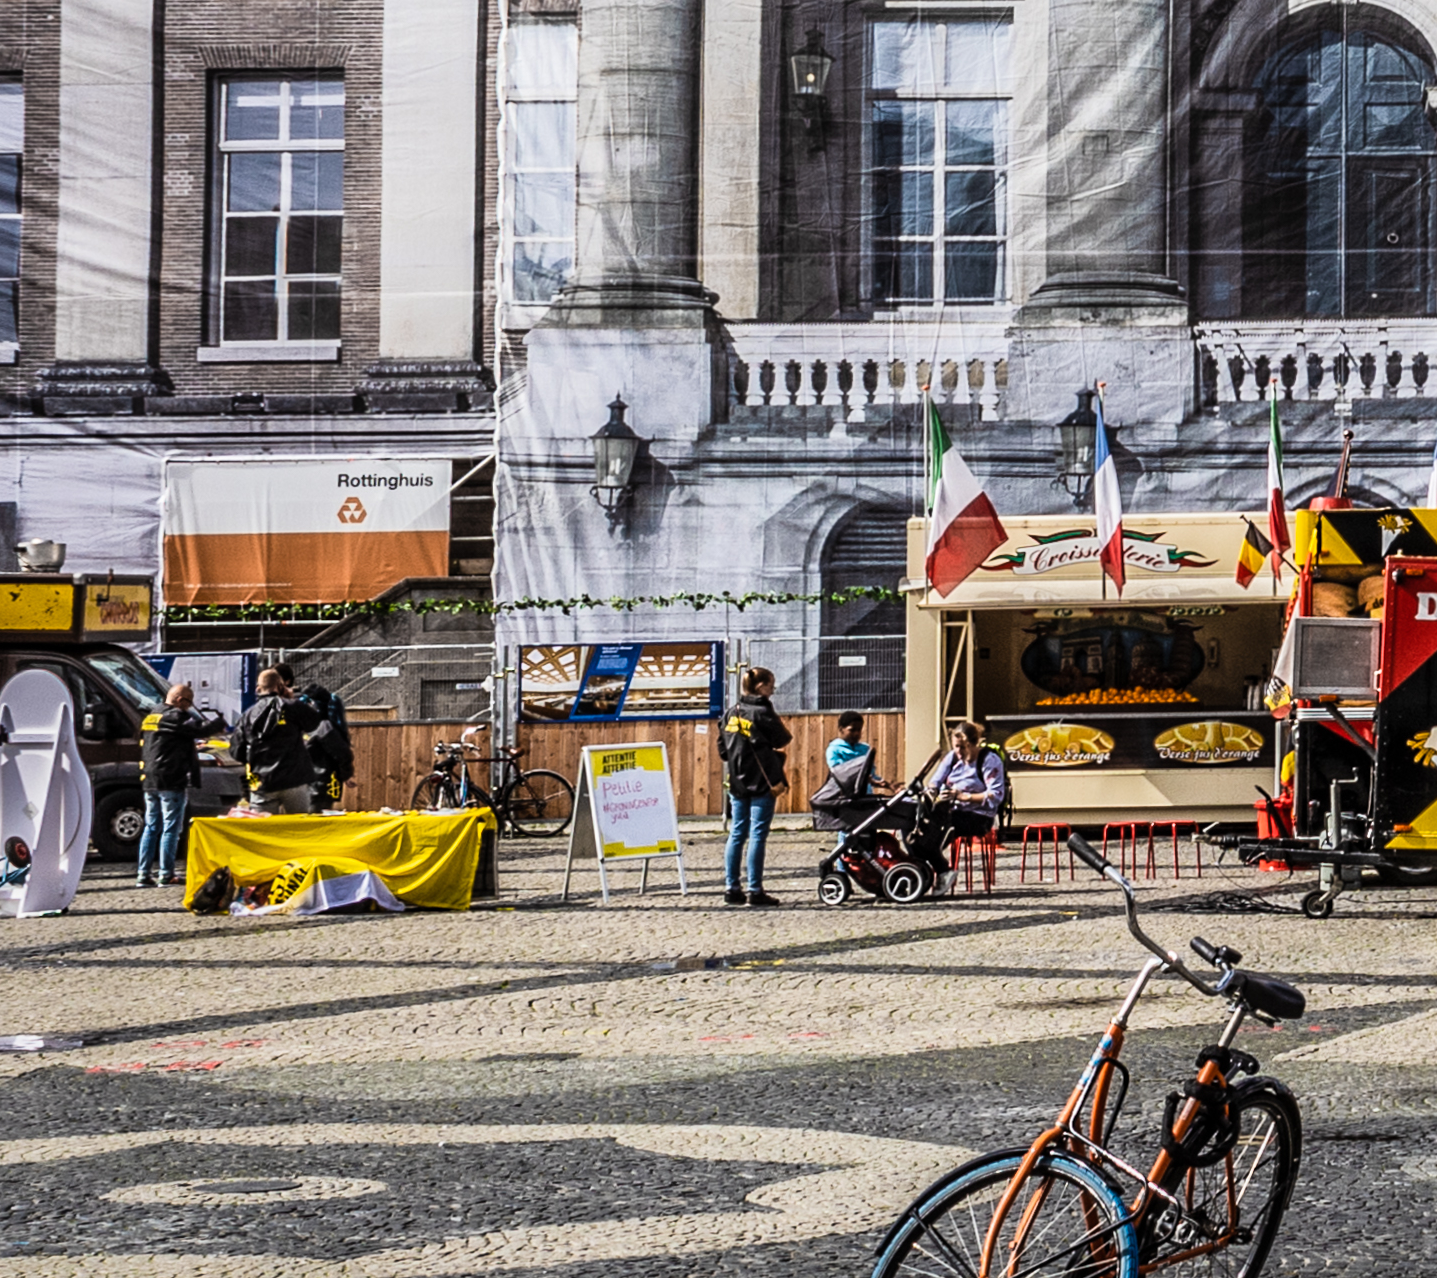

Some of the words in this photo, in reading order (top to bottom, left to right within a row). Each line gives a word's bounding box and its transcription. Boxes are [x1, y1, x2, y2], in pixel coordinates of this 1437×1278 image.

[337, 473, 434, 490] Rottinghuis
[602, 751, 636, 764] ATTENTIE
[1007, 750, 1041, 761] Verse
[1044, 750, 1061, 764] jus
[1157, 747, 1191, 758] Verse
[1194, 749, 1211, 762] jus
[602, 761, 636, 774] ATTENTIE
